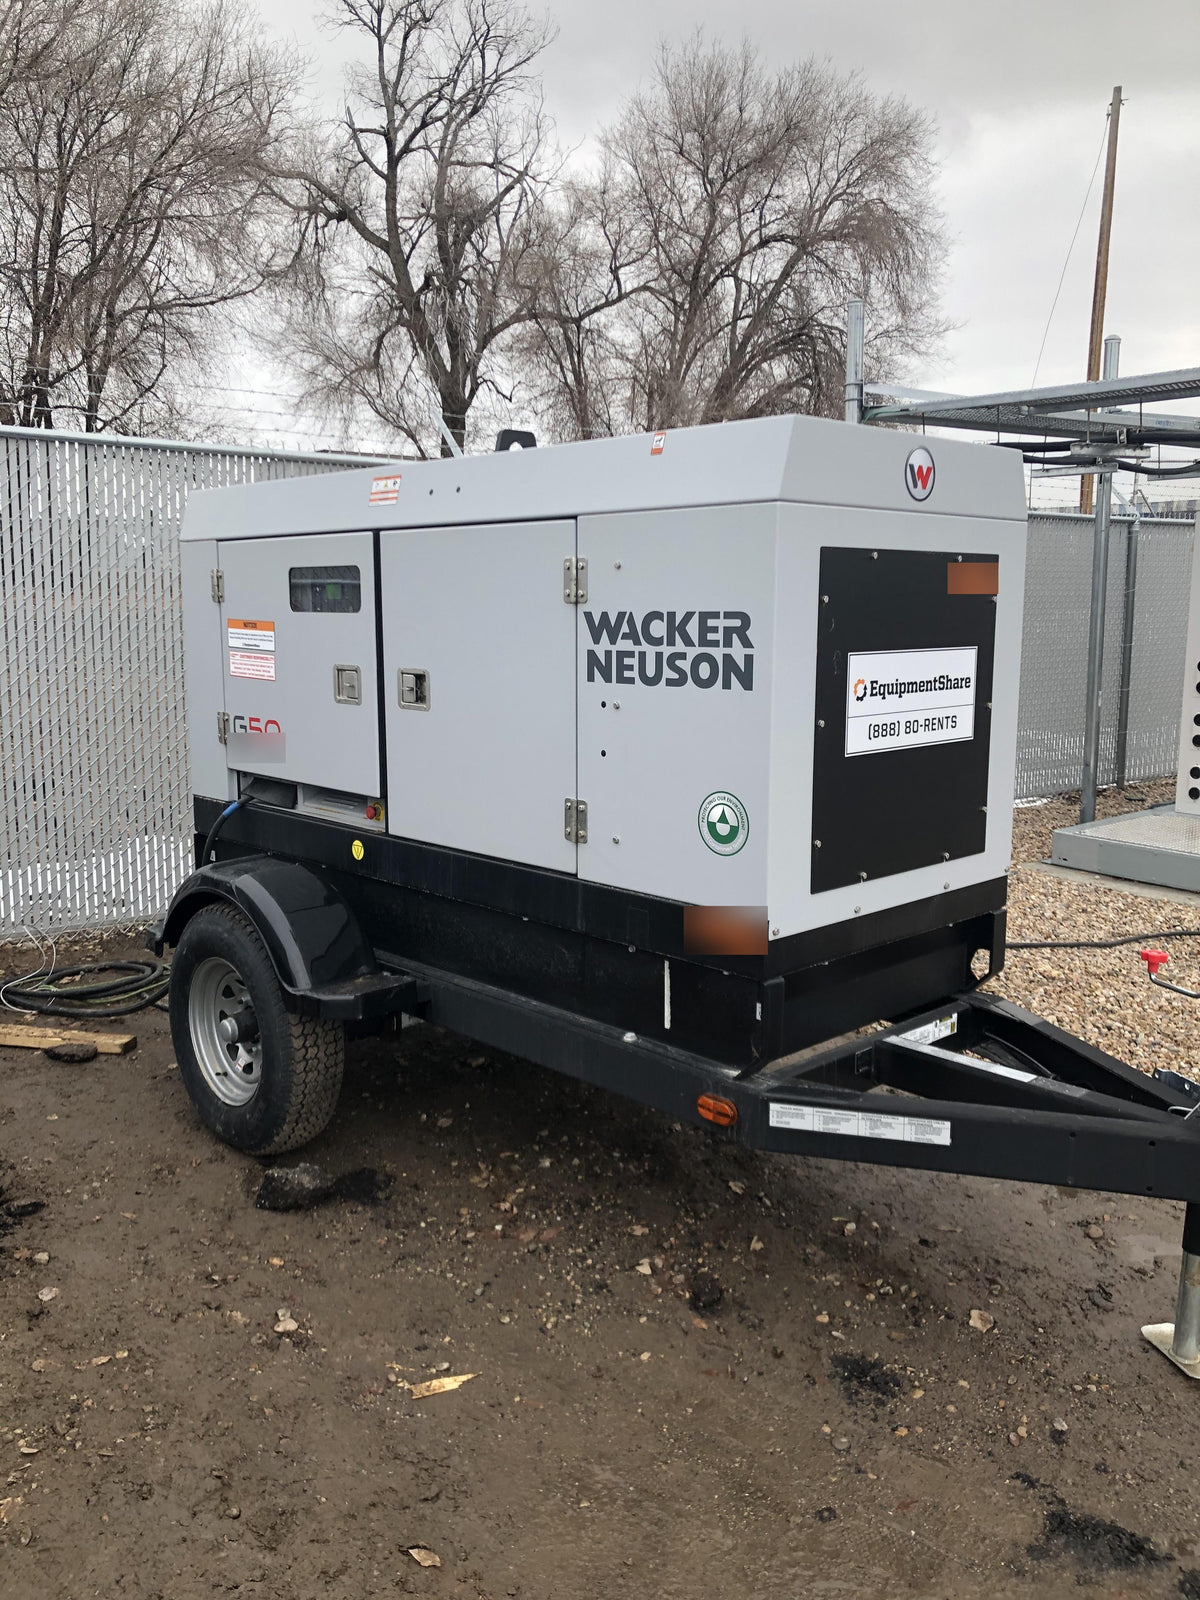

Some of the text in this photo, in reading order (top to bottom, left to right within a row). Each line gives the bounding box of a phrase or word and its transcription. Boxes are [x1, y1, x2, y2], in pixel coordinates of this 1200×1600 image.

[583, 610, 755, 649] WACKER
[586, 649, 754, 691] NEUSON
[869, 674, 971, 700] EquipmentShare
[868, 715, 958, 740] (888) 80-RENTS
[701, 797, 717, 823] PROTECTING
[726, 796, 746, 831] ENVIRONMENT
